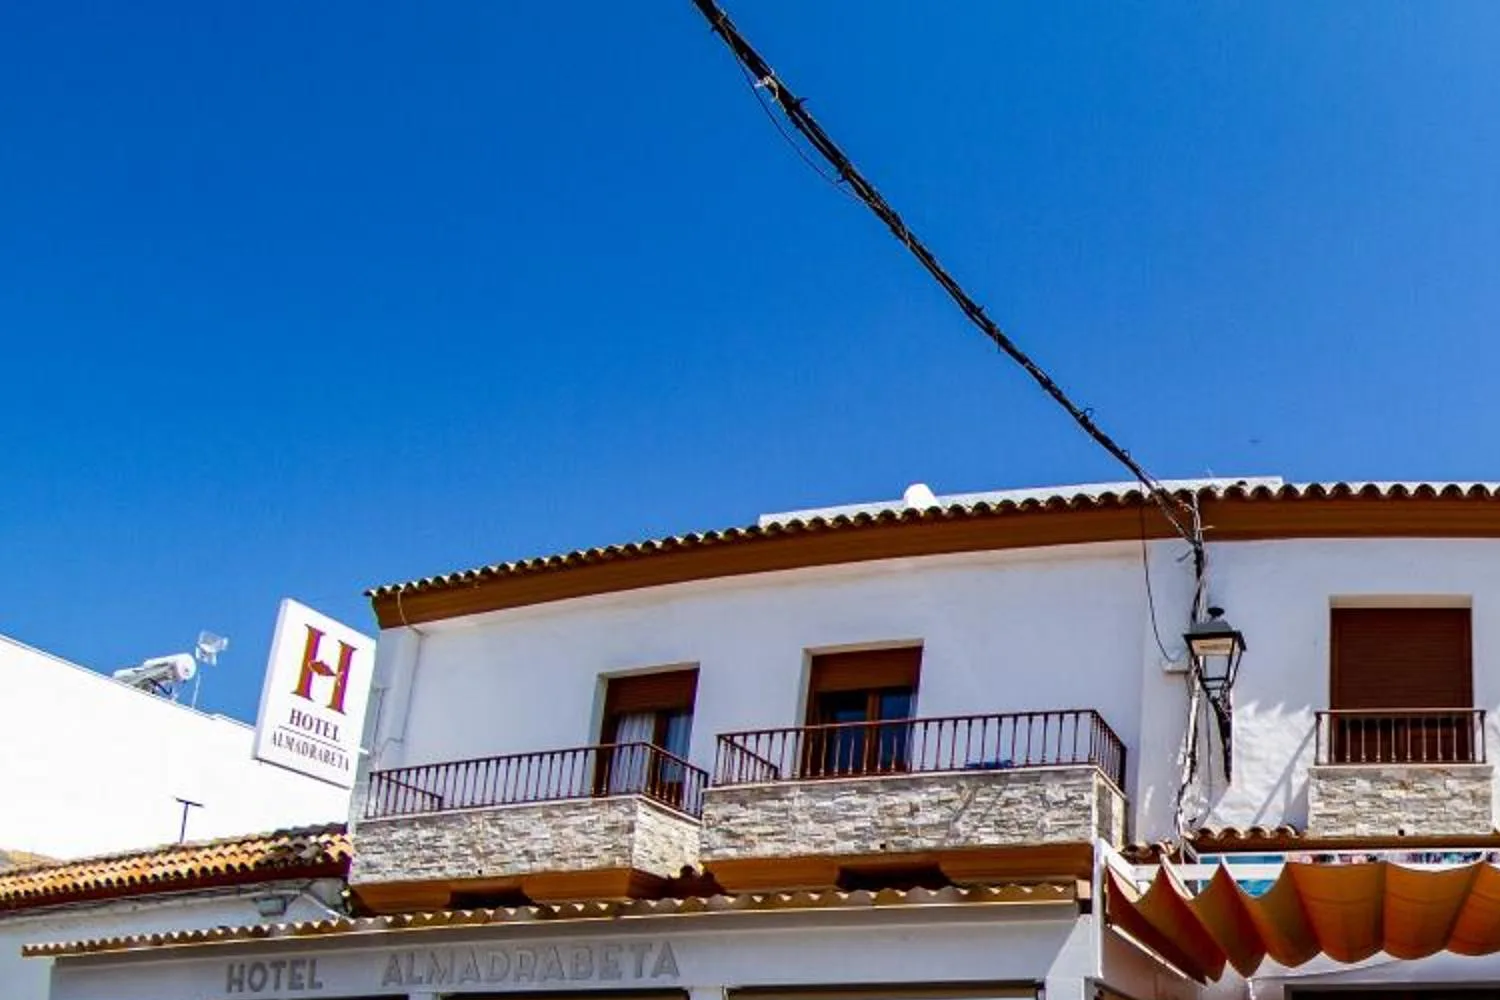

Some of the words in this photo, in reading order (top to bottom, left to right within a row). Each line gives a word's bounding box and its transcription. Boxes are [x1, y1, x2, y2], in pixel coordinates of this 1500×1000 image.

[291, 624, 357, 715] H
[289, 708, 340, 742] HOTEL
[272, 731, 349, 771] ALMADRABETA
[226, 958, 323, 993] HOTEL
[382, 942, 680, 986] ALMADRABETA
